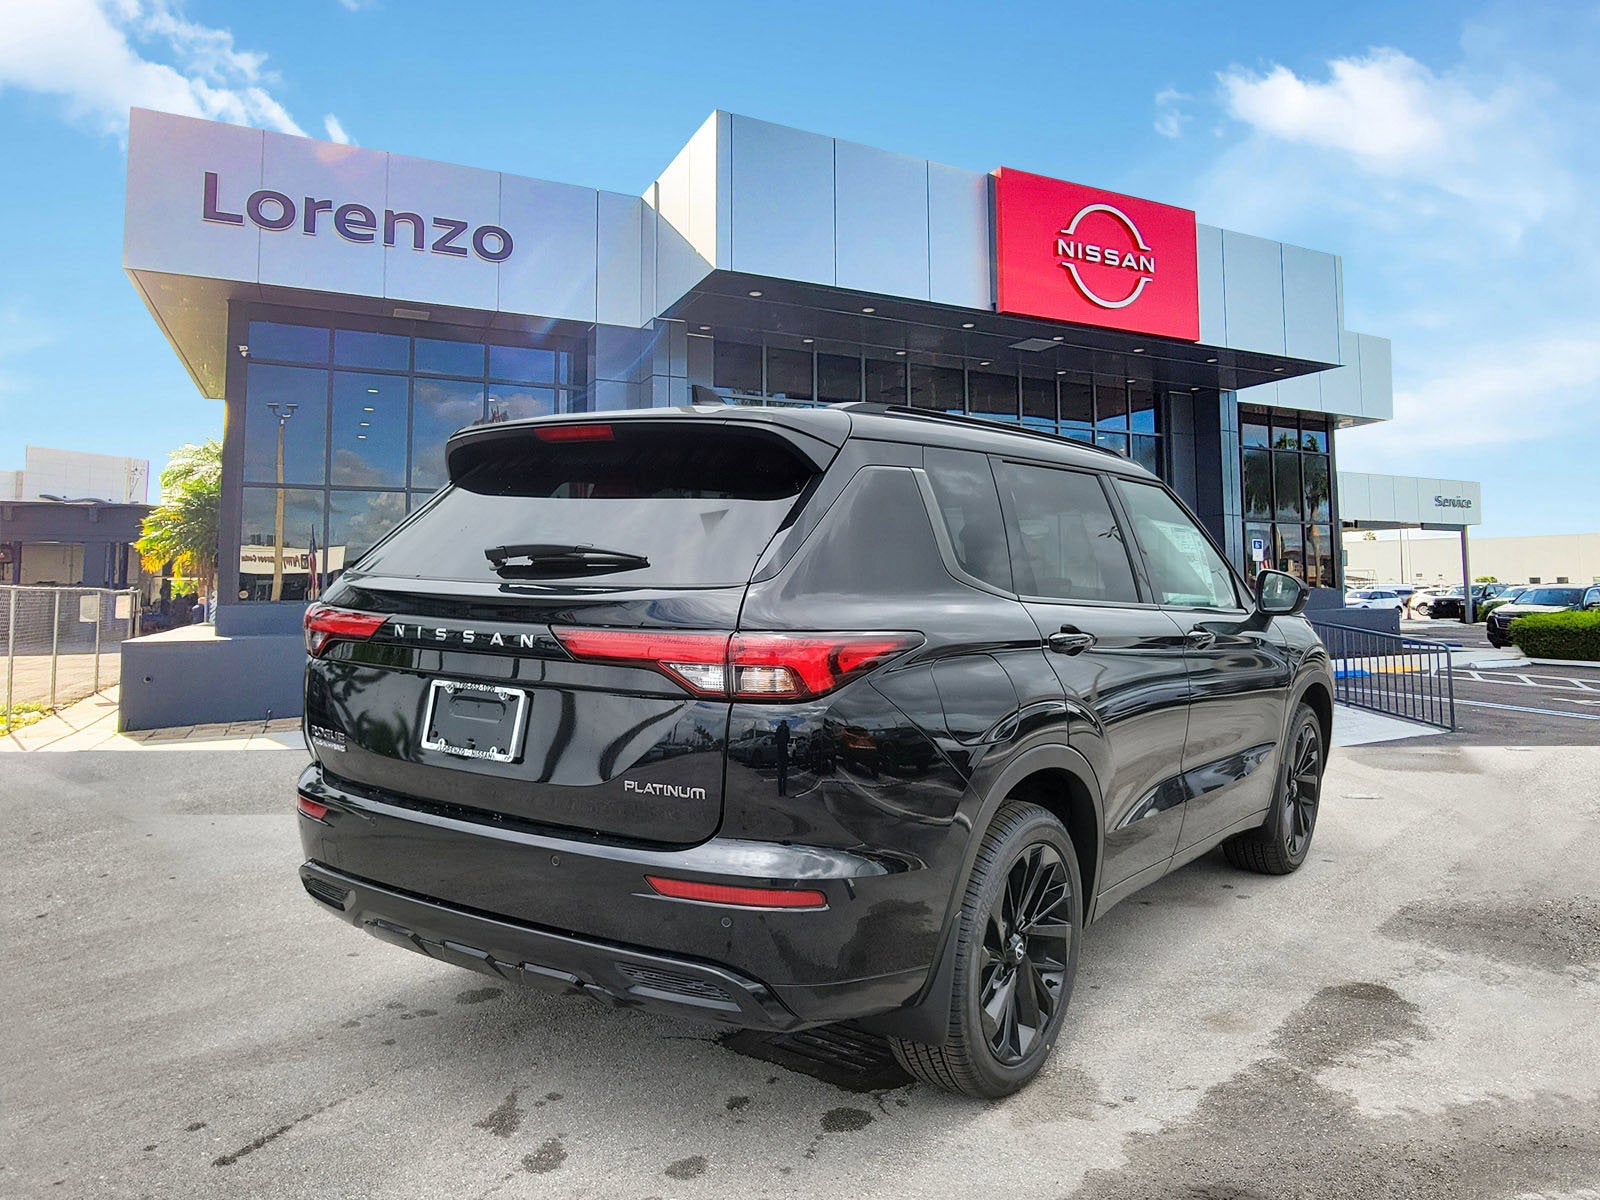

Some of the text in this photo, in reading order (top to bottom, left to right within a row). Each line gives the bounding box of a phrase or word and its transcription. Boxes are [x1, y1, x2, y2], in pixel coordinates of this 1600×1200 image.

[202, 170, 514, 263] Lorenzo
[1056, 237, 1156, 274] NISSAN
[1434, 495, 1472, 509] Service
[393, 623, 535, 649] NISSAN
[311, 724, 346, 744] ROGUE
[623, 780, 706, 800] PLATINUM
